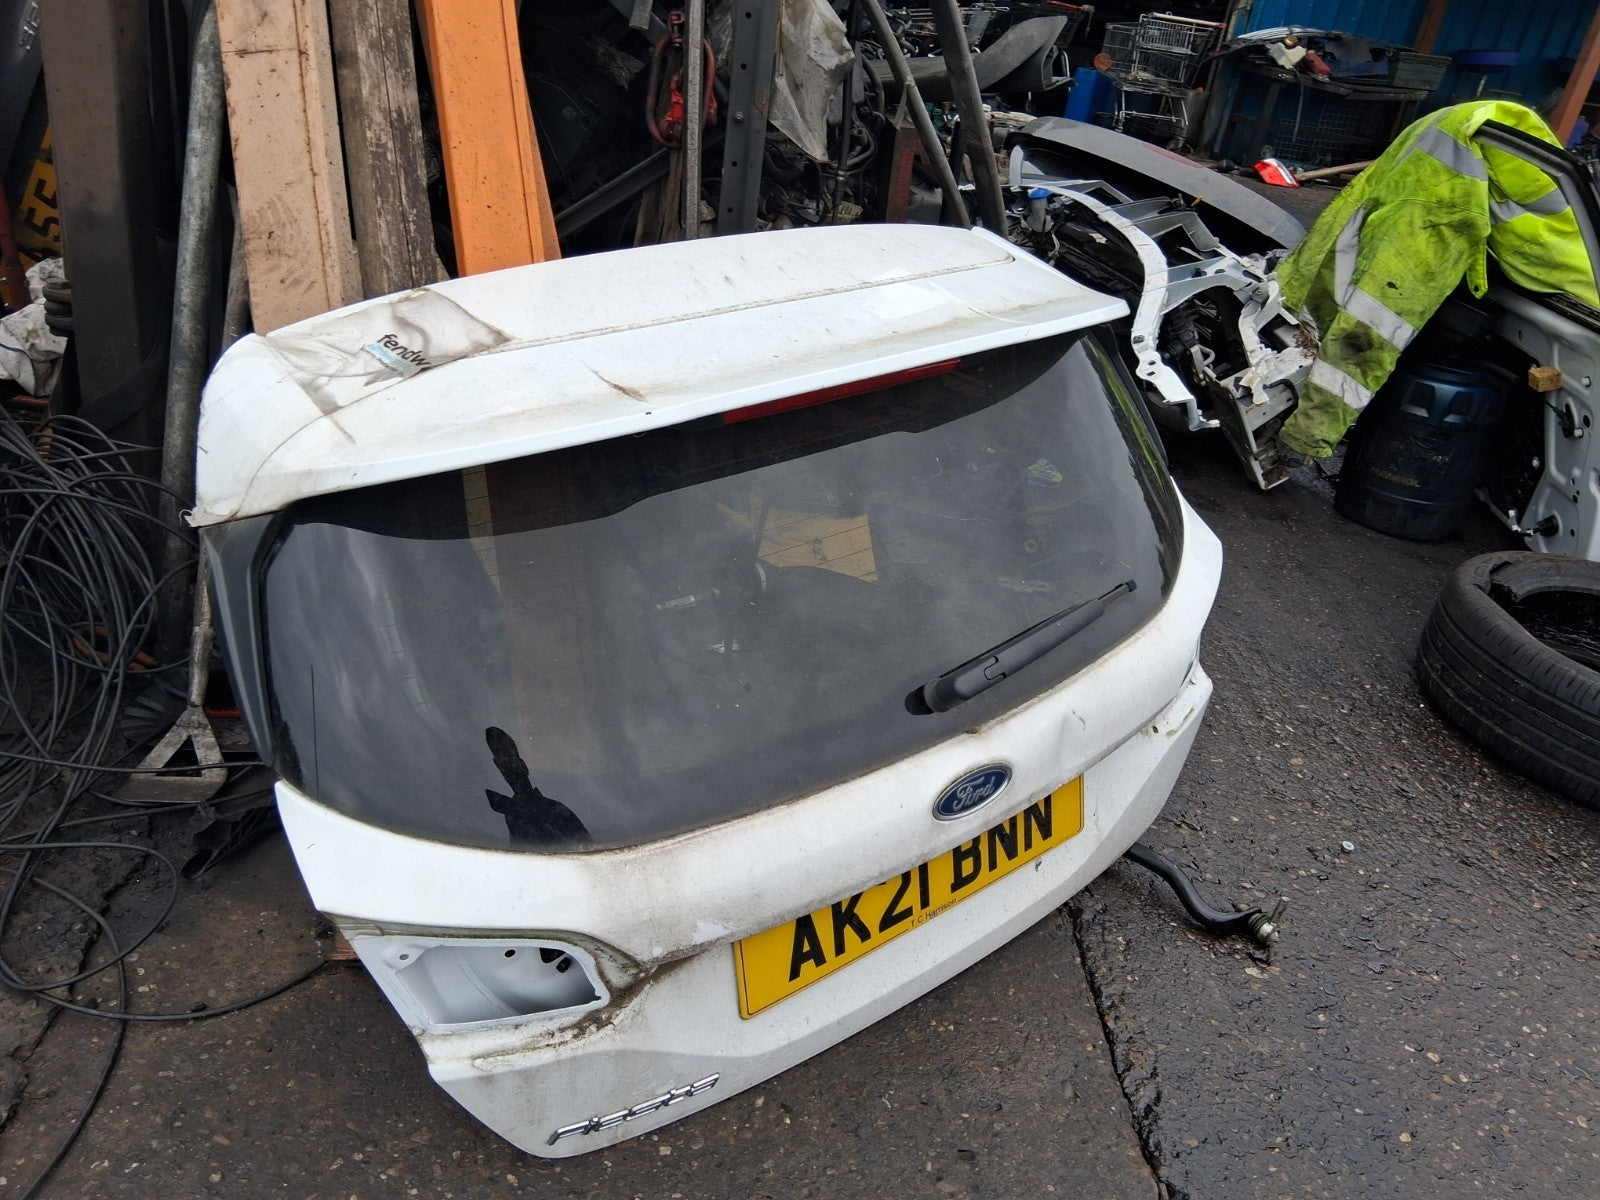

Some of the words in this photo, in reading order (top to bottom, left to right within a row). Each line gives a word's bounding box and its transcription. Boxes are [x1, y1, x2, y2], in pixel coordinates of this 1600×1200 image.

[953, 775, 995, 812] Ford
[788, 861, 930, 982] AK21
[950, 794, 1053, 894] BNN
[925, 898, 957, 920] Harrison
